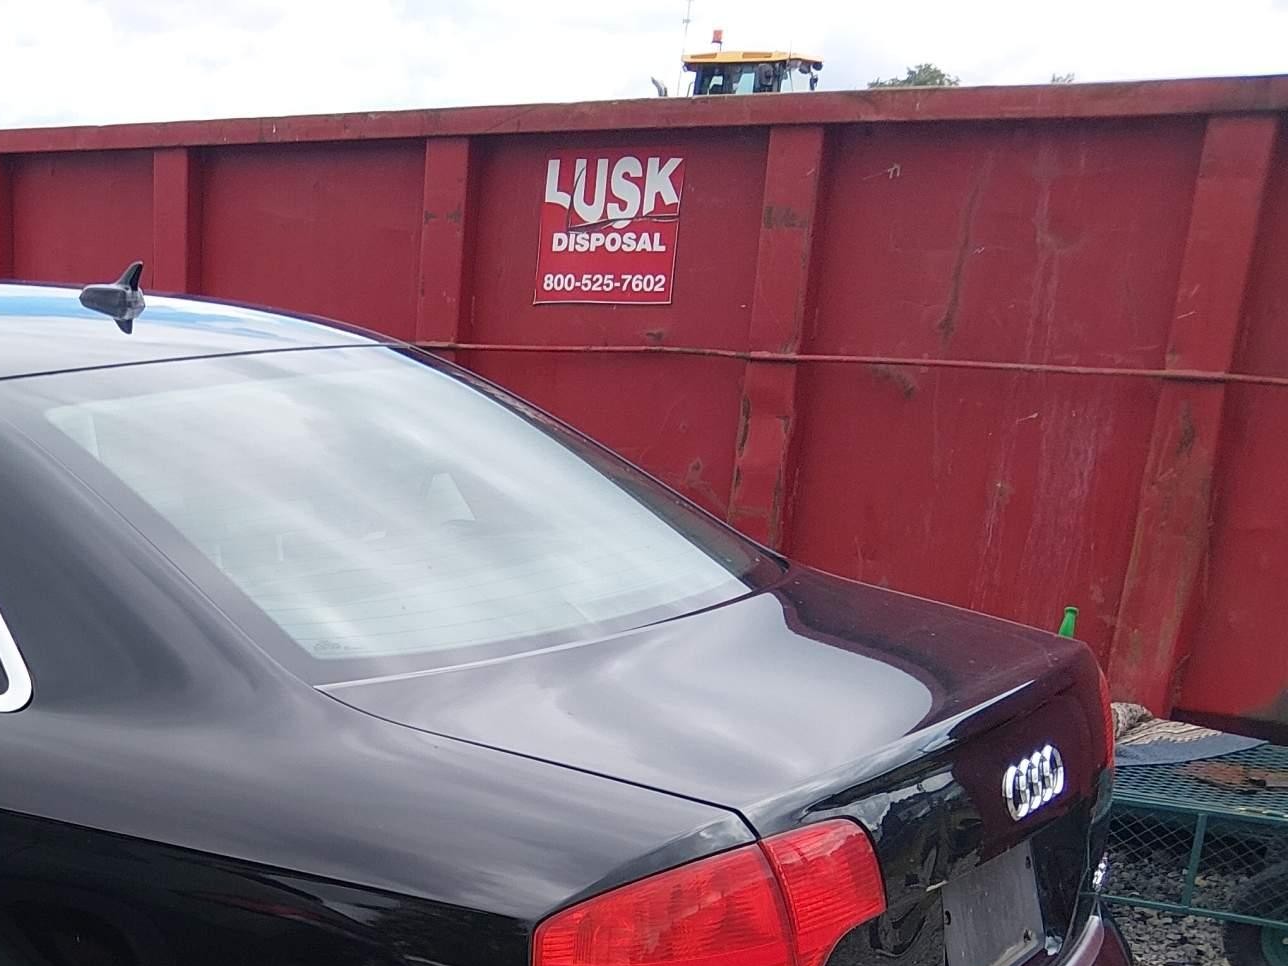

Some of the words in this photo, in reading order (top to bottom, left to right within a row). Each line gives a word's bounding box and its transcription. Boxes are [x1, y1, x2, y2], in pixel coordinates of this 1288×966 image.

[545, 156, 683, 229] LUSK
[552, 232, 666, 252] DISPOSAL
[543, 274, 666, 292] 800-525-7602
